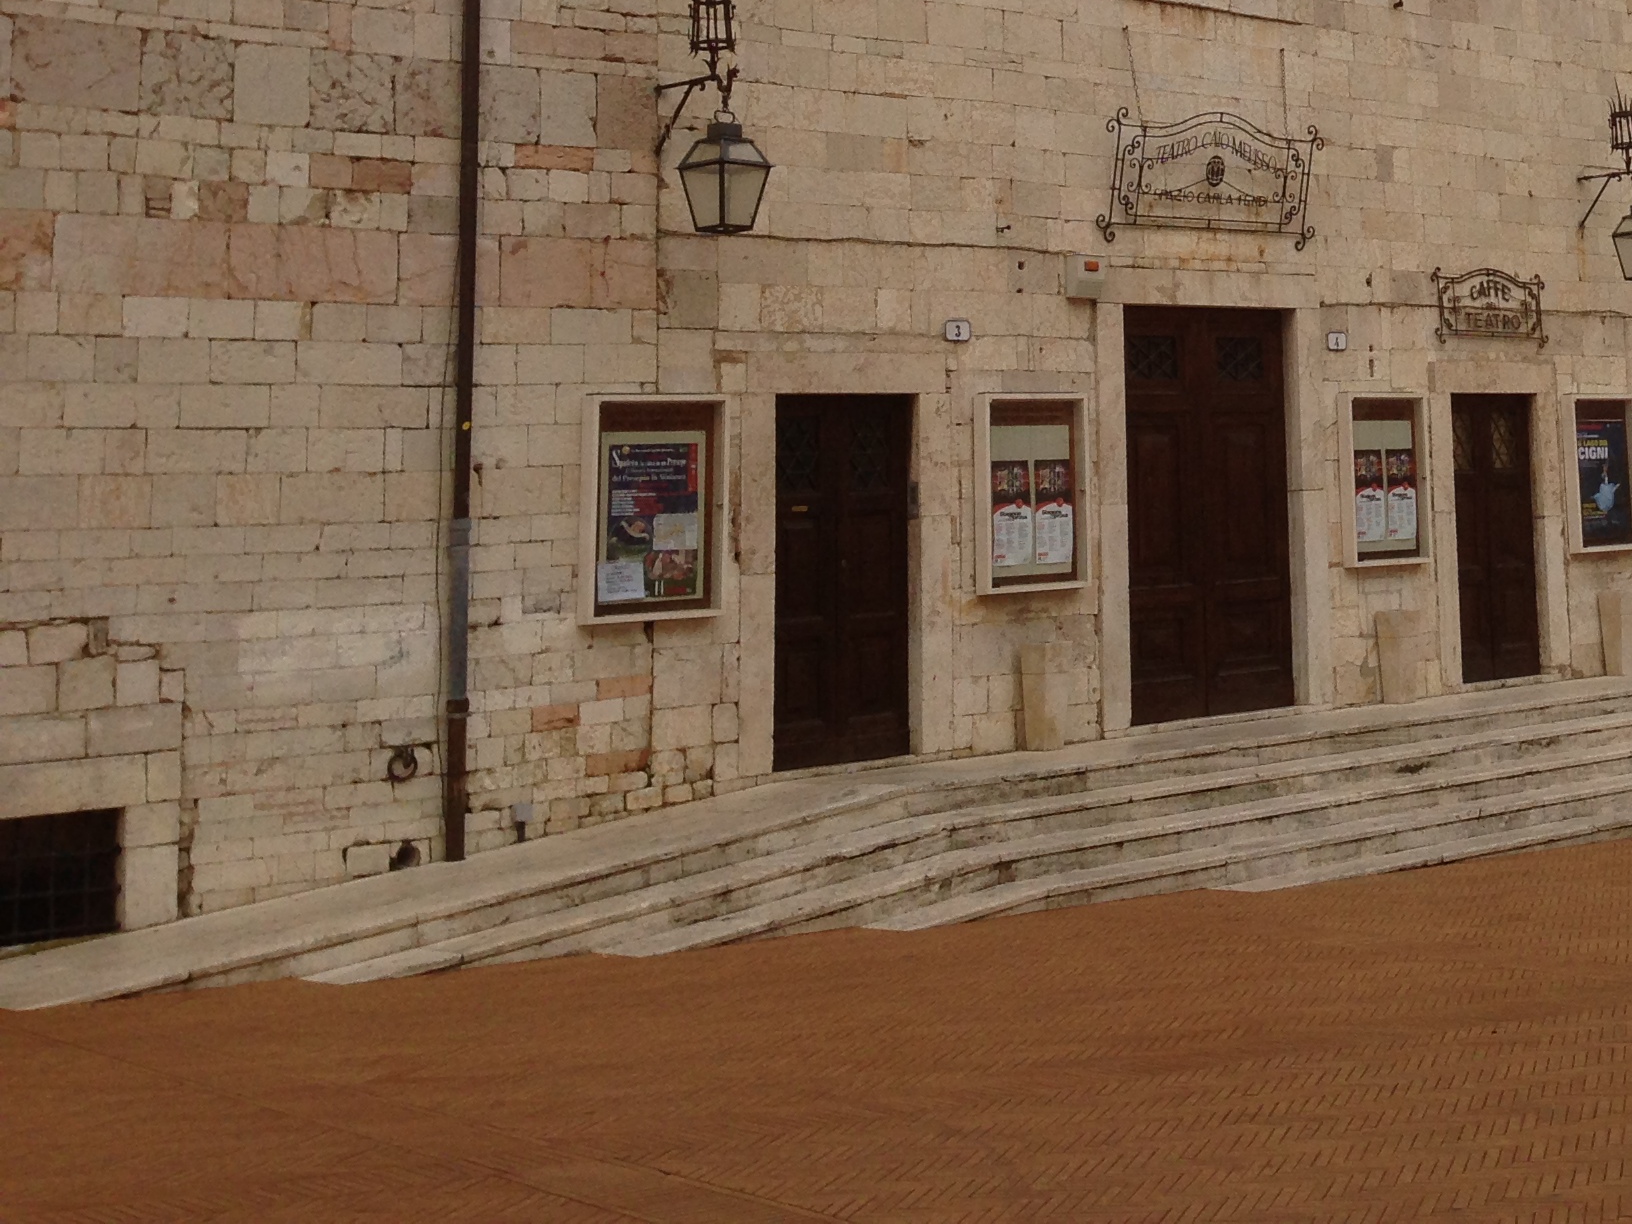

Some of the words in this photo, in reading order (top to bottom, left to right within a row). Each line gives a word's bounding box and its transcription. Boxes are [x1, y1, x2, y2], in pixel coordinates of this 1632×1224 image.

[1155, 136, 1199, 164] TEATRO
[1202, 131, 1230, 150] CAIO
[1231, 135, 1279, 174] MELISSO
[1196, 190, 1234, 206] CARLA
[1464, 312, 1521, 330] TEATRO
[954, 324, 962, 338] 3
[1578, 447, 1609, 460] CIGNI
